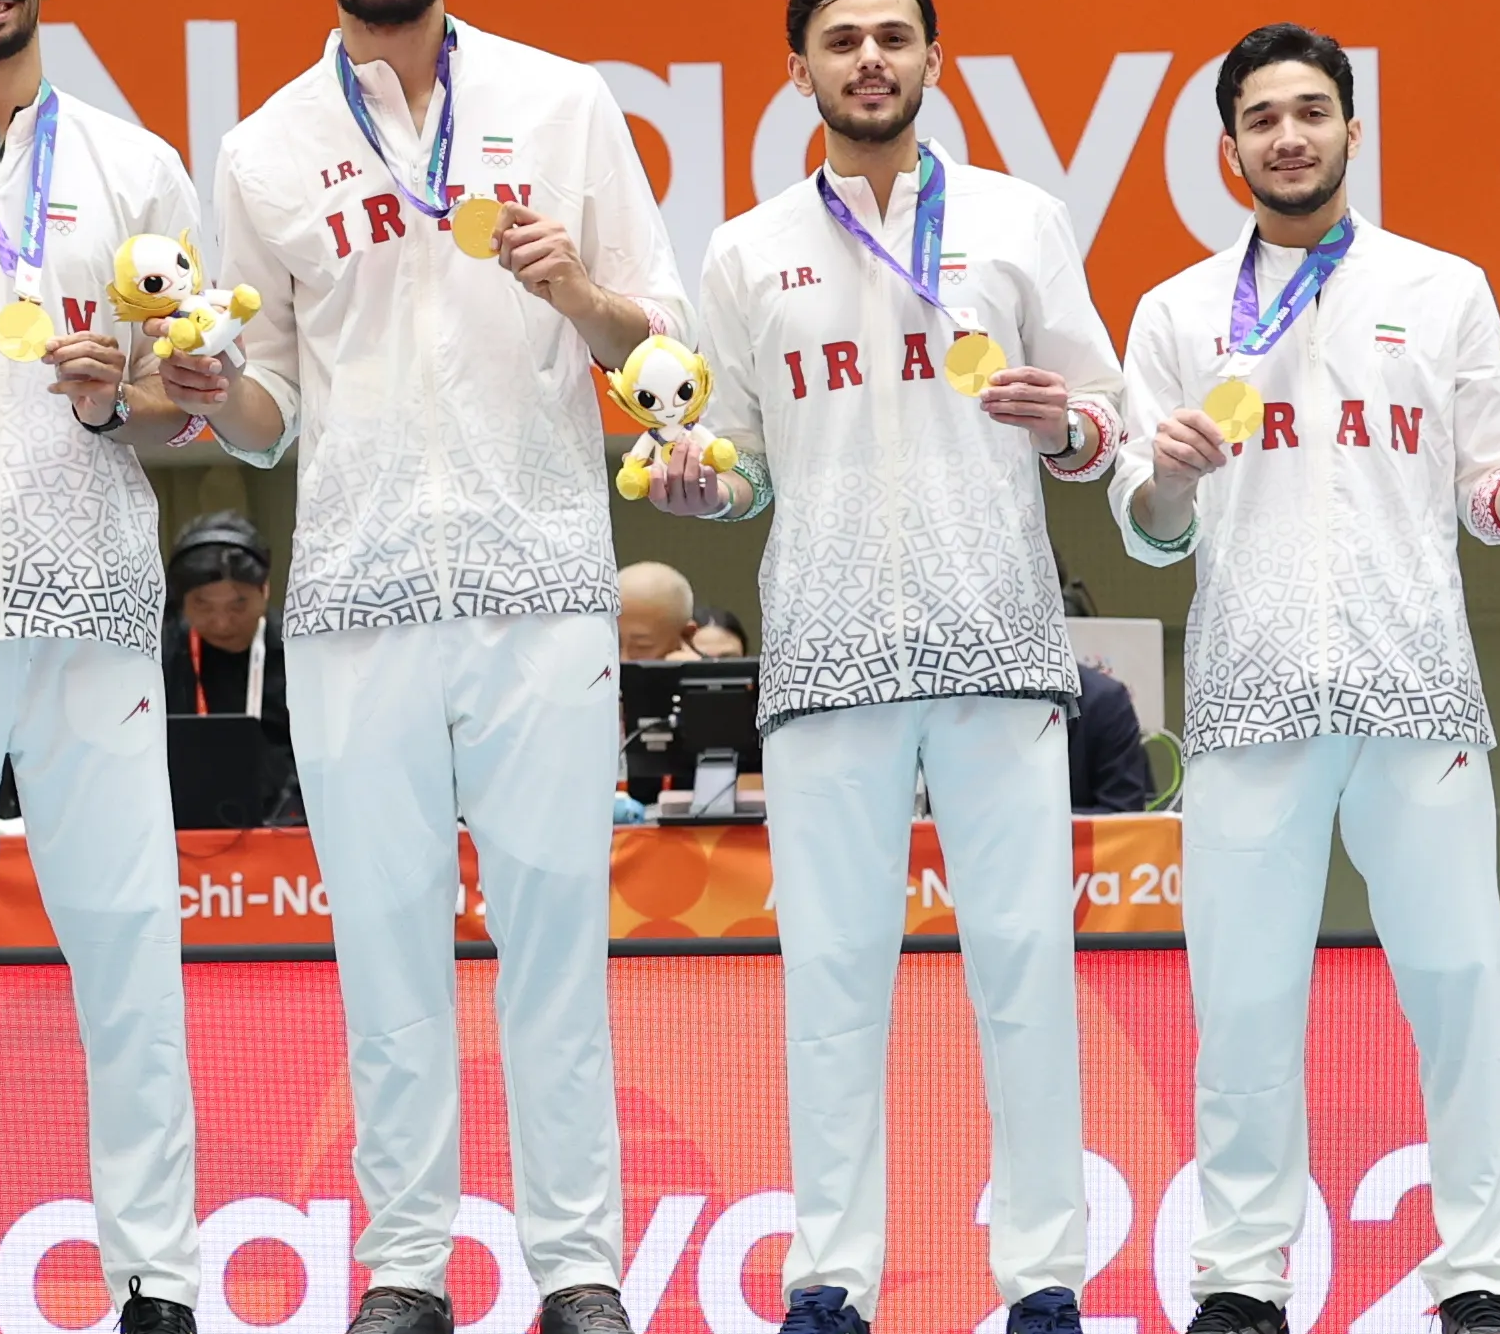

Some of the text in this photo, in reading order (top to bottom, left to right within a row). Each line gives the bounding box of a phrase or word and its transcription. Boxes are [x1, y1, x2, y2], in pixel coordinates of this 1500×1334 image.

[320, 160, 362, 189] I.R.
[780, 267, 822, 290] I.R.
[784, 331, 988, 400] IRA
[1231, 399, 1423, 457] RAN
